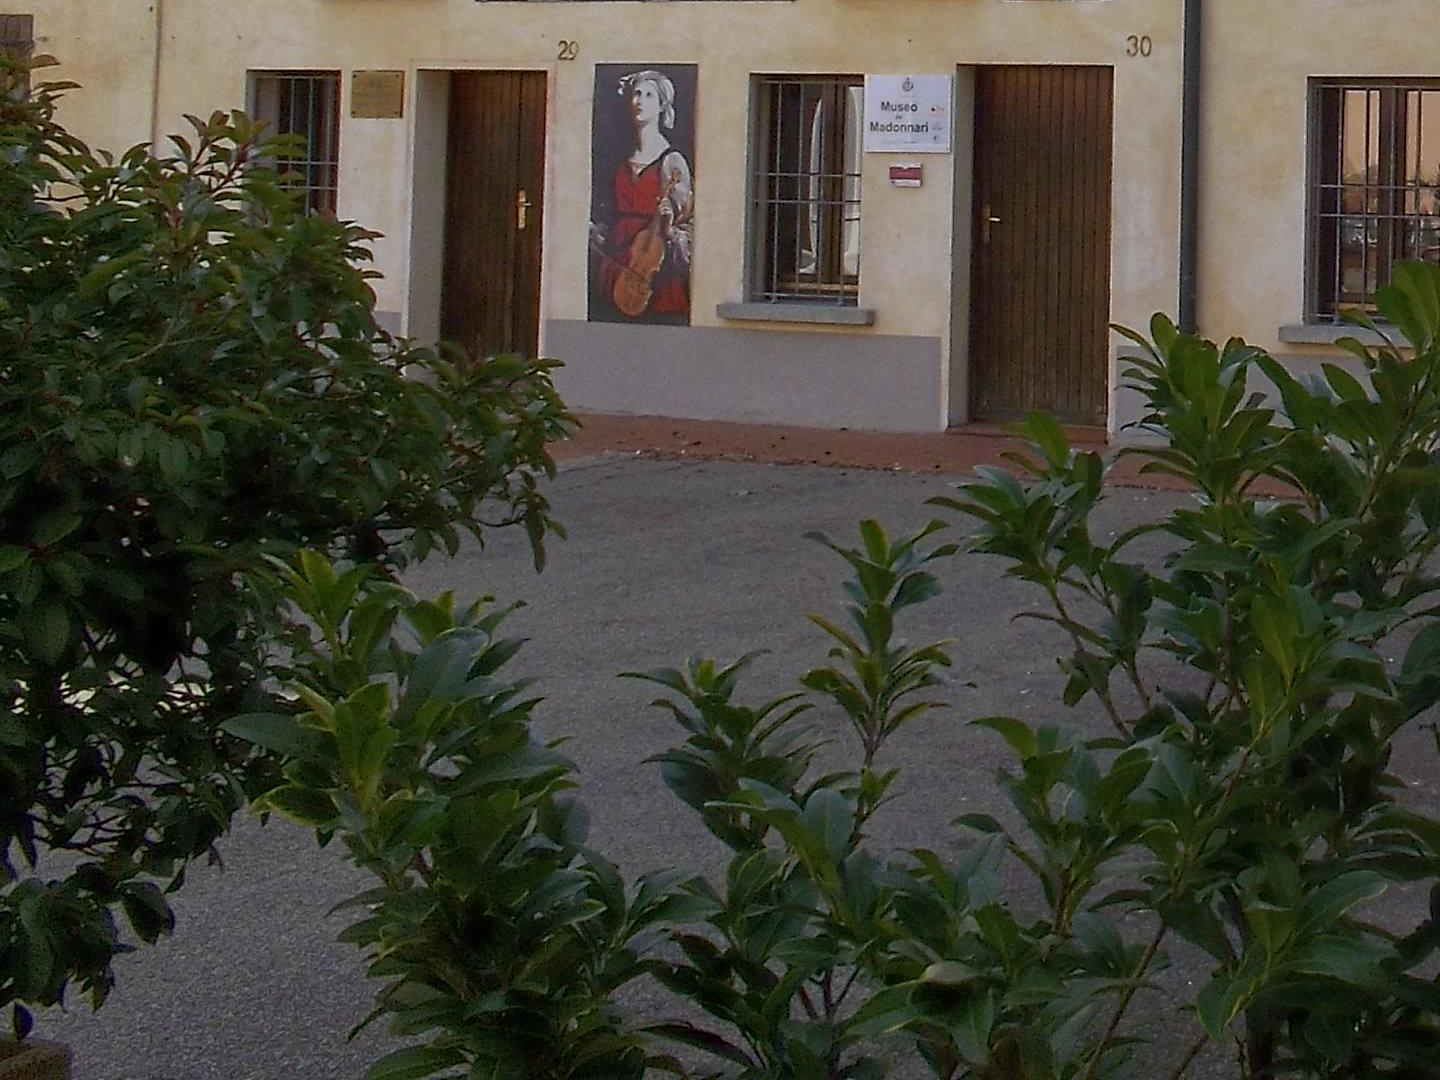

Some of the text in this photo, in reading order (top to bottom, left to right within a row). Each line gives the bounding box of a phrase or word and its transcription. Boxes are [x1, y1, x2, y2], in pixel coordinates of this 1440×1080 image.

[558, 40, 579, 60] 29
[1126, 35, 1152, 57] 30
[881, 101, 918, 112] Museo
[869, 121, 929, 133] Madonnari
